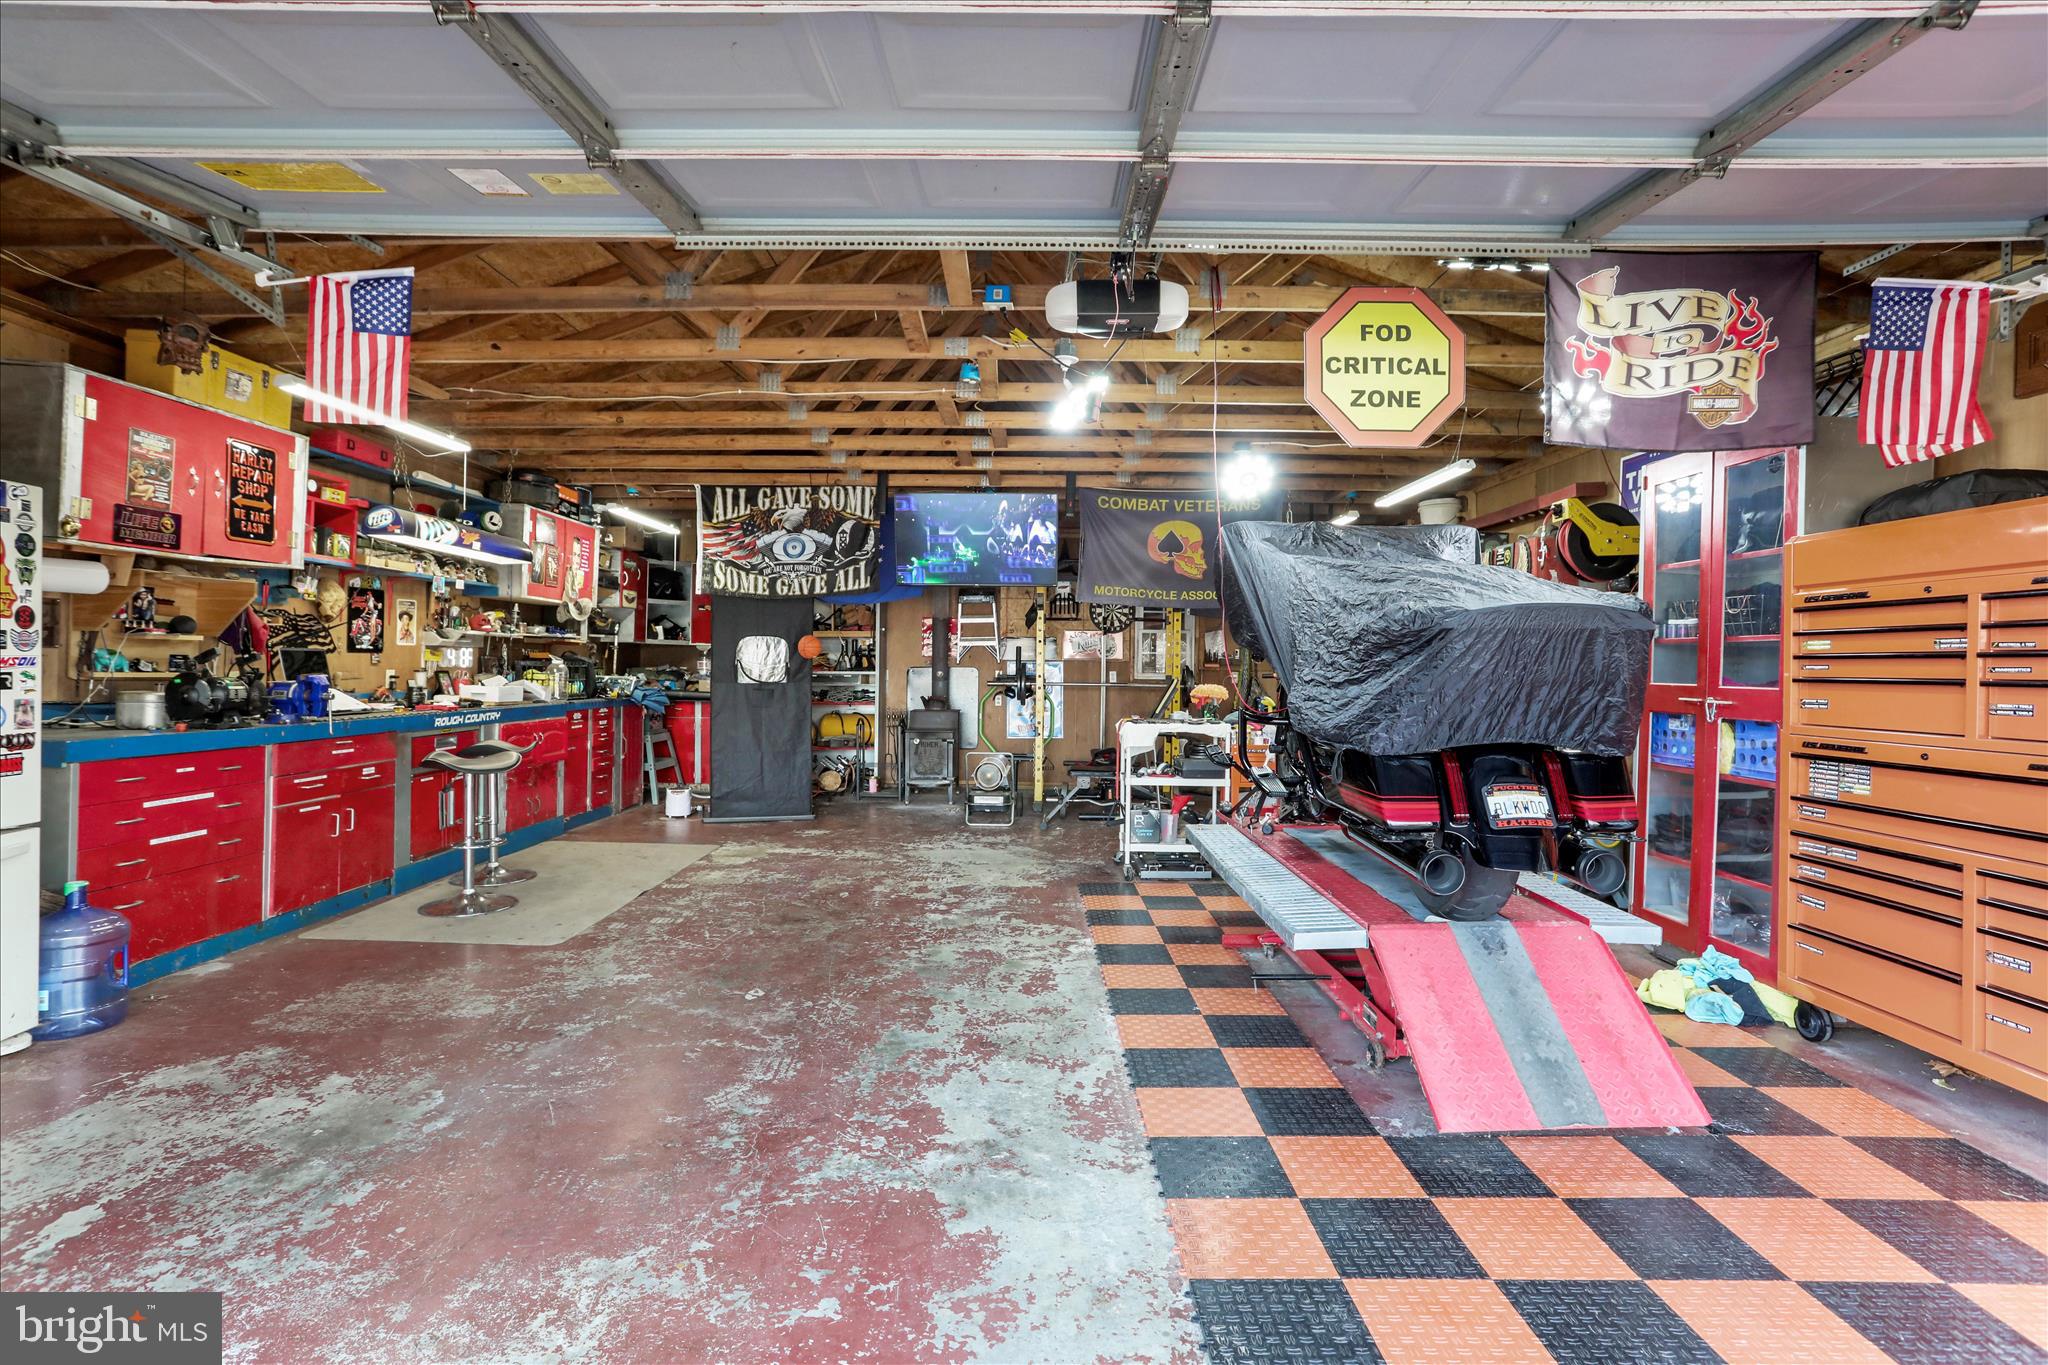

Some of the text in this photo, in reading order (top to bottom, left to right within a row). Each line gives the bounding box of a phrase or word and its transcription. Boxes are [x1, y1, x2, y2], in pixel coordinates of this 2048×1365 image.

[1586, 295, 1721, 329] LIVE
[1360, 324, 1411, 342] FOD
[1325, 356, 1447, 375] CRITICAL
[1622, 355, 1752, 390] RIDE
[1350, 389, 1421, 408] ZONE
[232, 448, 273, 471] HARLEY
[231, 462, 274, 486] REPAIR
[237, 479, 269, 497] SHOP
[712, 486, 877, 523] ALL GAVE SOME
[1097, 495, 1261, 513] COMBAT VETERANS
[120, 511, 160, 530] LIFE
[234, 508, 271, 524] WE TAKE
[240, 521, 264, 535] CASH
[713, 559, 870, 595] SOME GAVE ALL
[1094, 585, 1177, 600] MOTORCYCLE
[0, 656, 37, 667] MSOIL
[434, 711, 501, 727] ROUGH COUNTRY
[1496, 819, 1554, 827] HATERS
